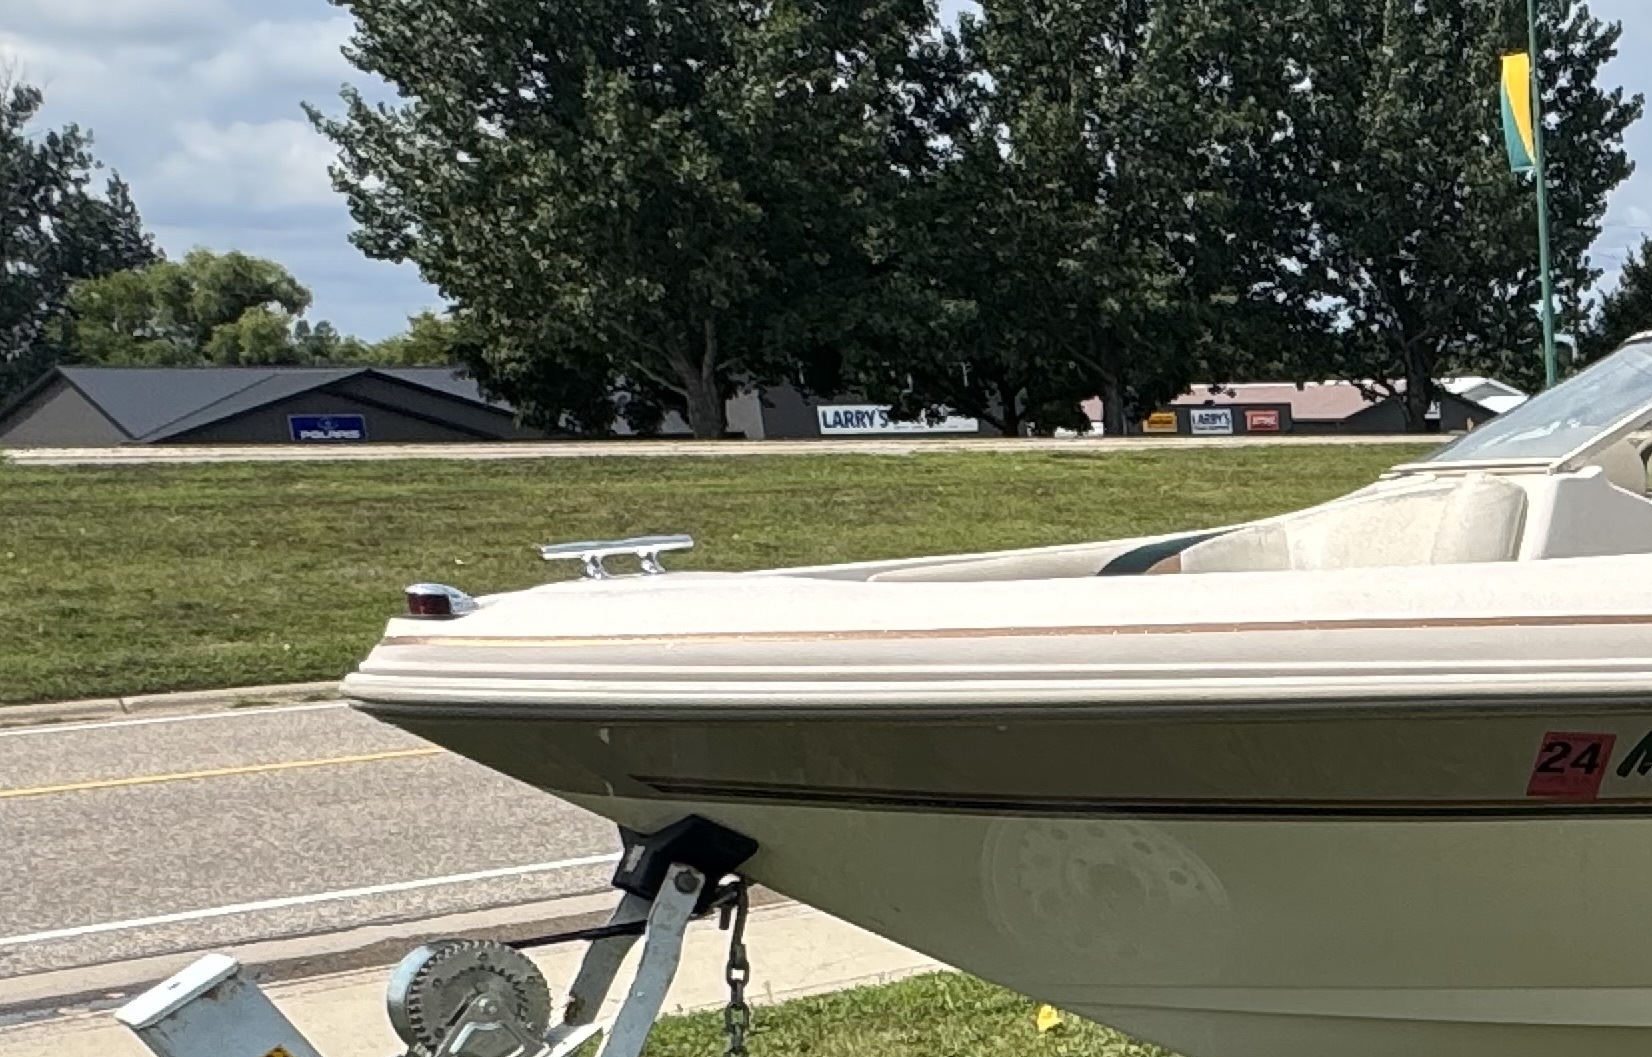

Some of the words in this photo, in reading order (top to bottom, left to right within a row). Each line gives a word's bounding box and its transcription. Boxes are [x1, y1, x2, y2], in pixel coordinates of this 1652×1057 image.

[822, 408, 889, 429] LARRY'S
[300, 429, 360, 440] POLARIS
[1535, 741, 1603, 775] 24
